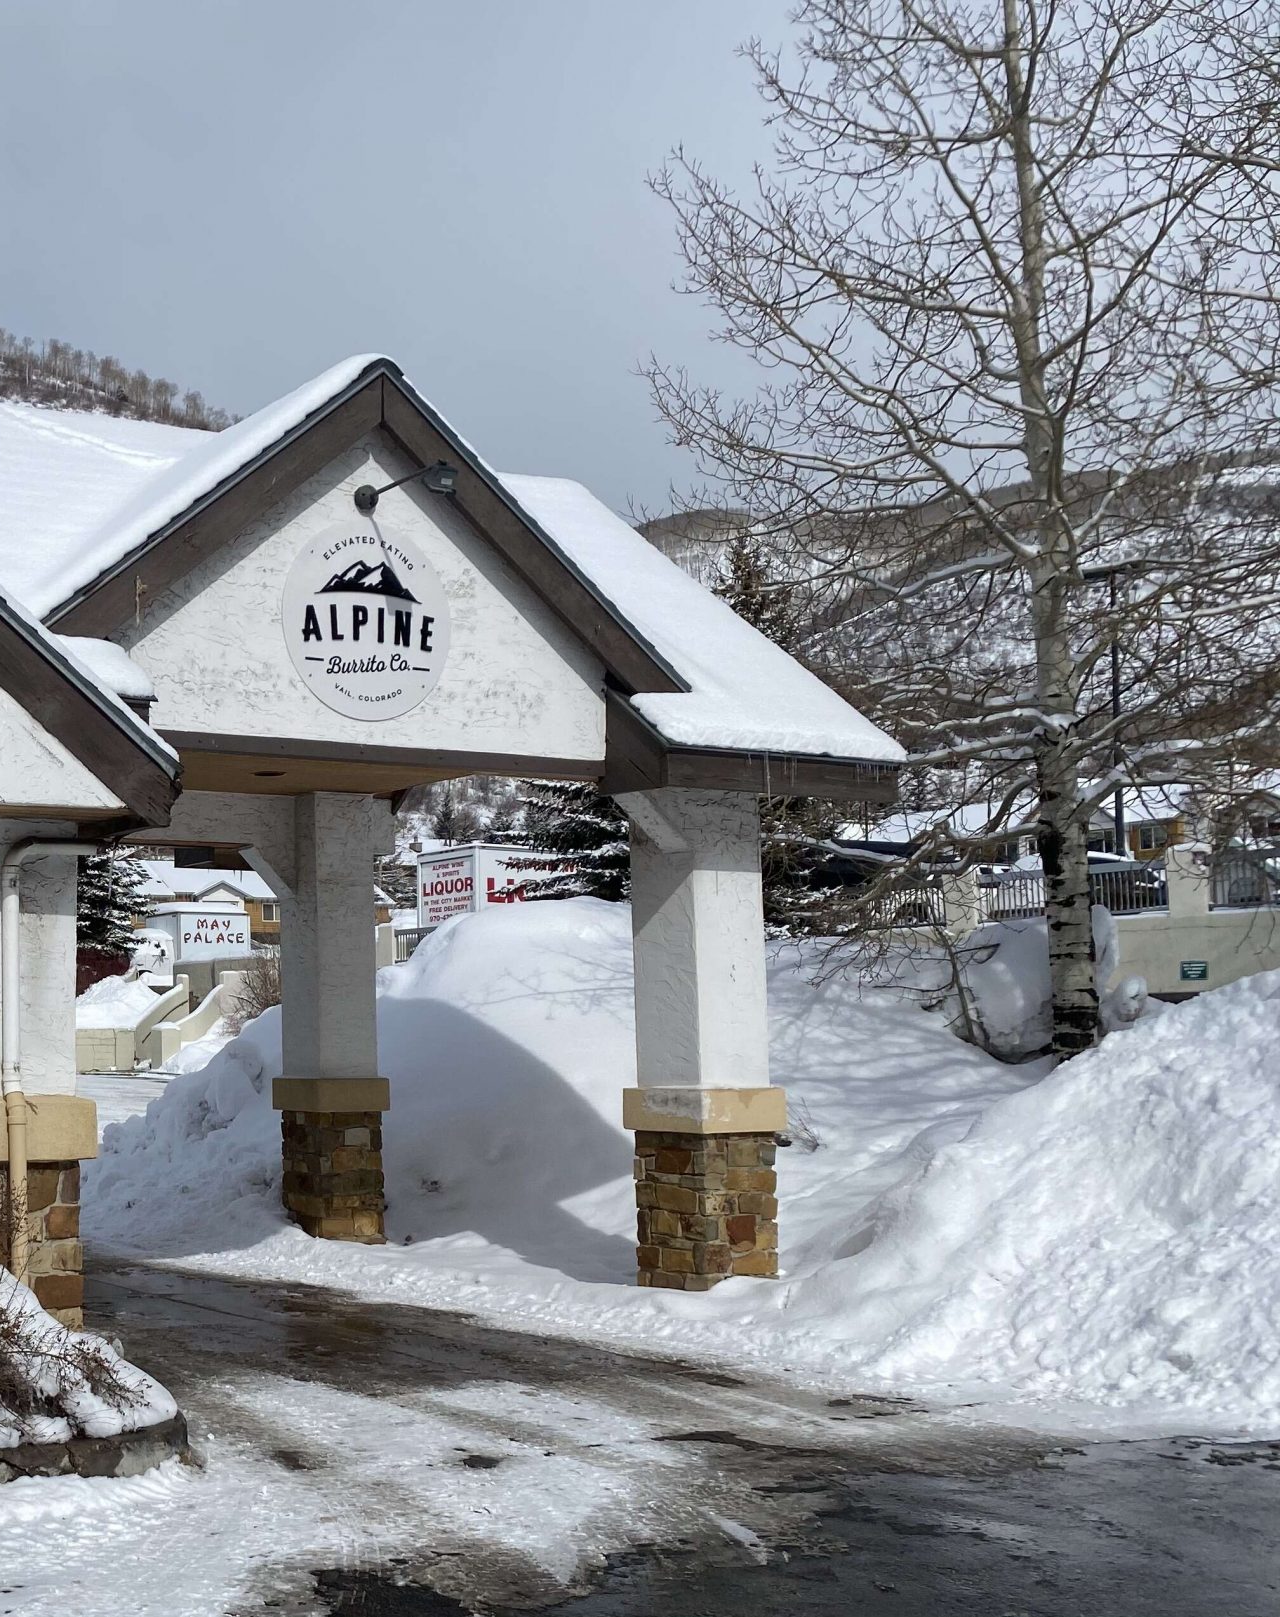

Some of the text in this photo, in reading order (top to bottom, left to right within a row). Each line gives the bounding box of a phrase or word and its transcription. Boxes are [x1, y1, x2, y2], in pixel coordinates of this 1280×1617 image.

[323, 536, 414, 570] ELEVATED EATING
[302, 604, 434, 652] ALPINE
[326, 654, 410, 674] Burrito Co.
[335, 683, 402, 702] VAIL, COLORADO
[423, 877, 474, 897] LIQUOR
[197, 918, 230, 931] MAY
[184, 932, 244, 944] PALACE
